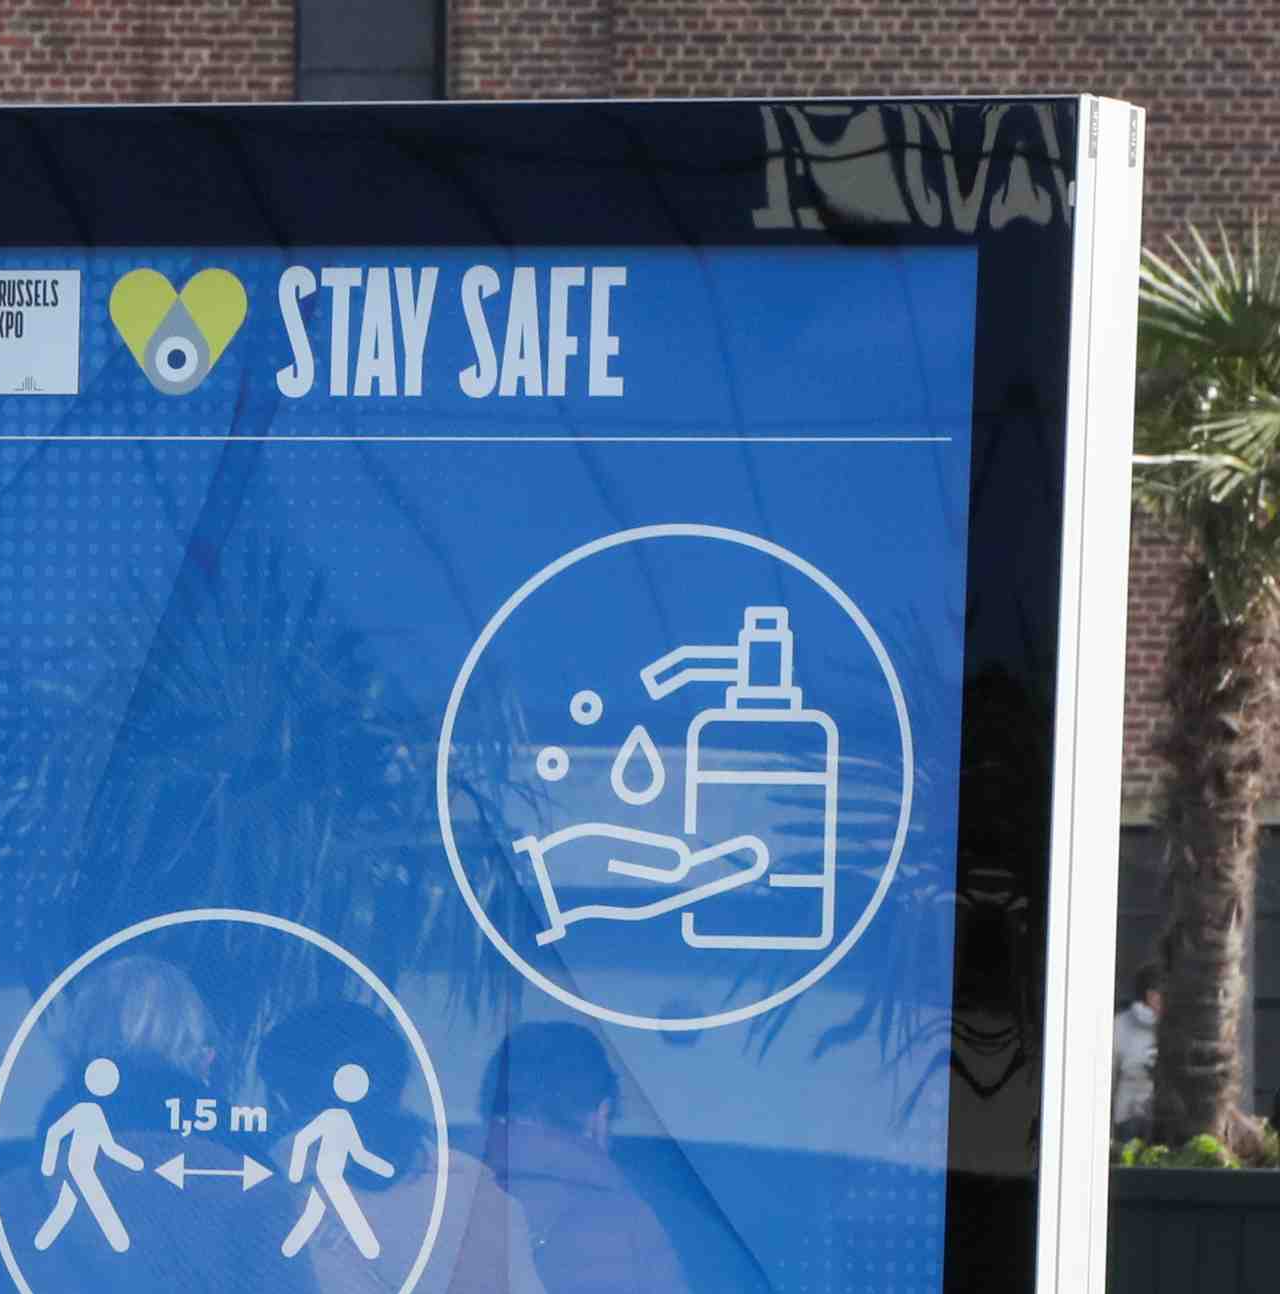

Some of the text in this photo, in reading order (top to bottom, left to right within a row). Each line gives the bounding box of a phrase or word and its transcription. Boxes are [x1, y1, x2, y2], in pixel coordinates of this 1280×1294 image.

[276, 265, 627, 398] STAY SAFE
[165, 1098, 267, 1136] 1,5 m
